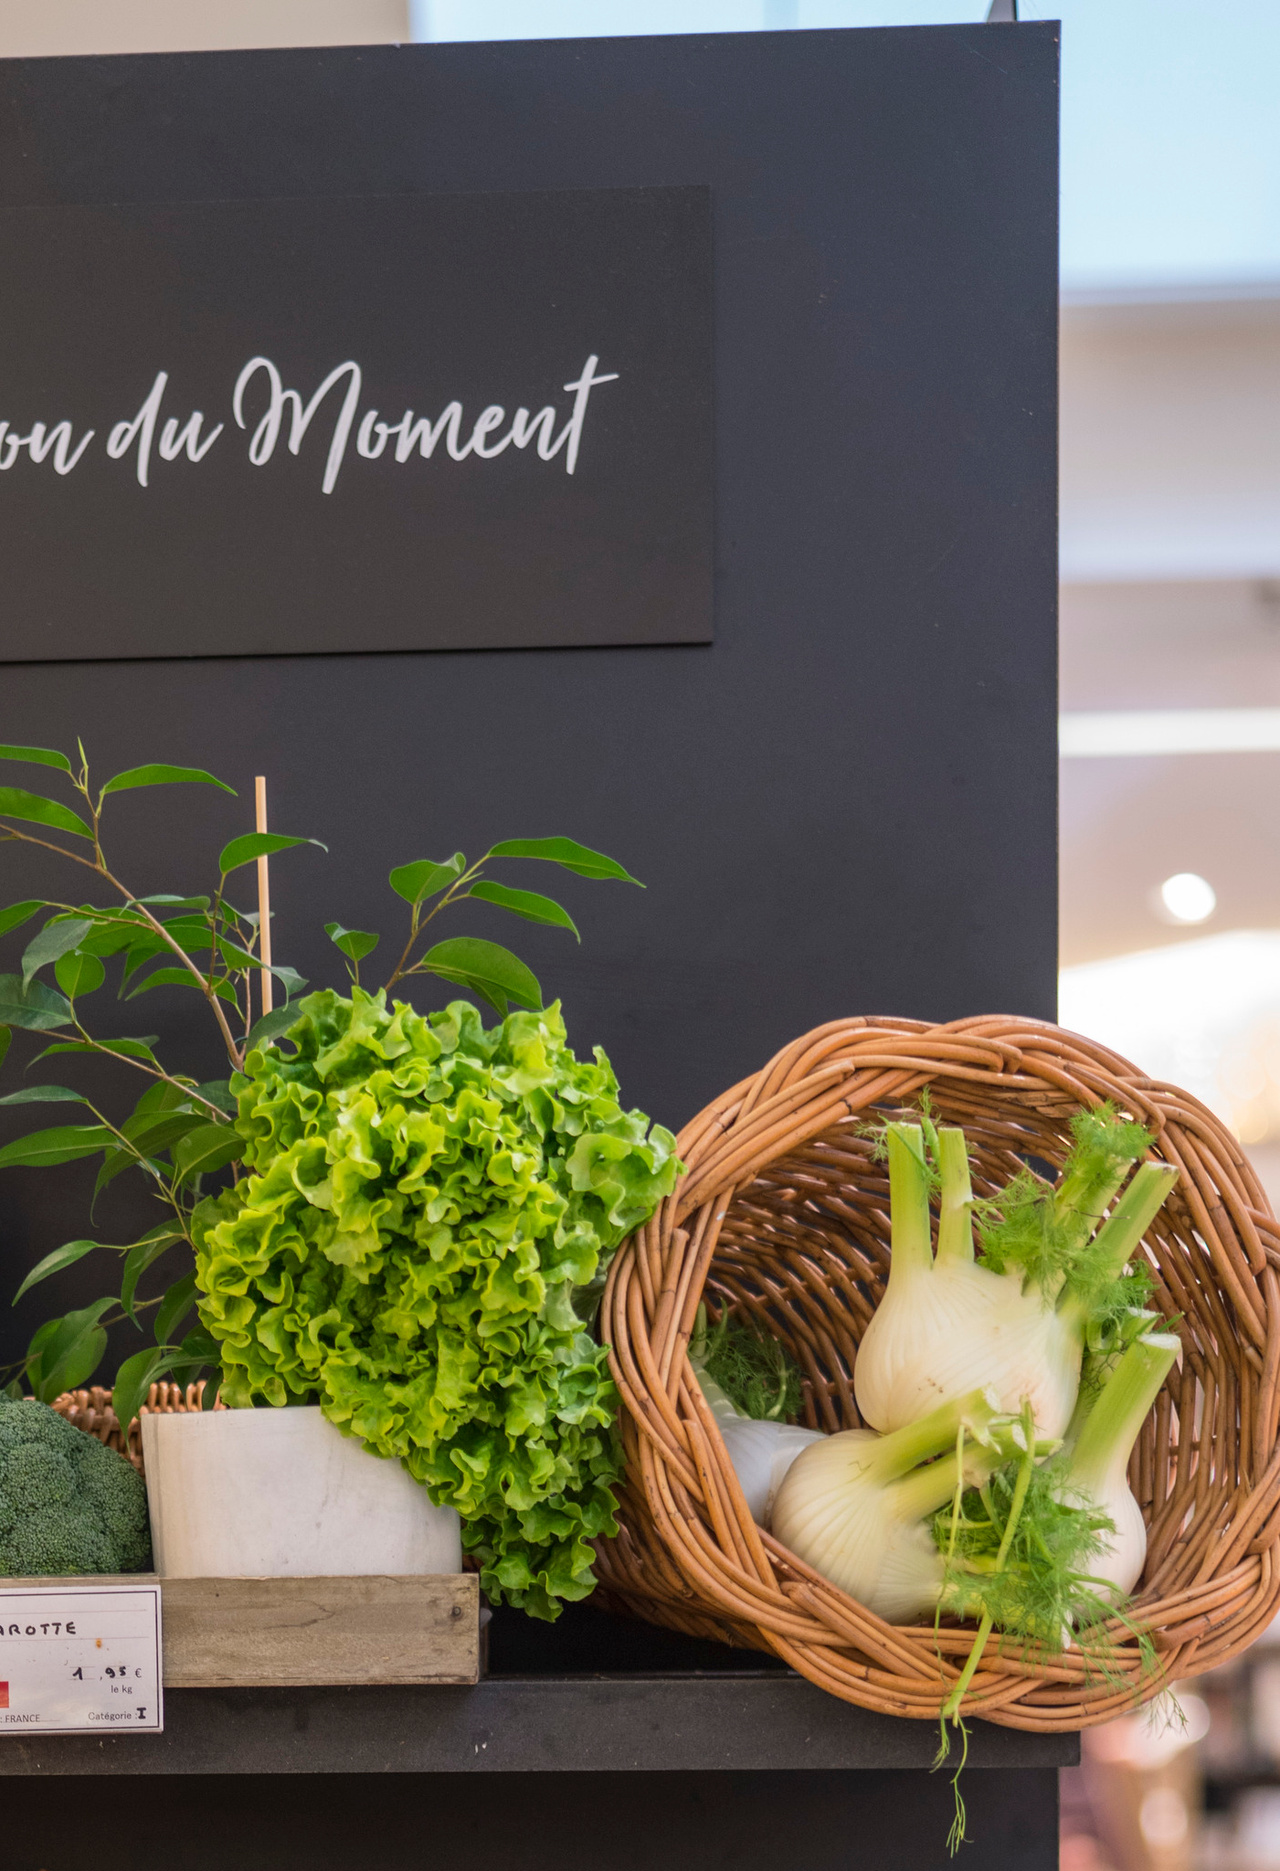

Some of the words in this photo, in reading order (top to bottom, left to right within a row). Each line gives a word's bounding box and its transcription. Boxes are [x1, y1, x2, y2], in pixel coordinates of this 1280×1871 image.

[106, 371, 223, 487] du
[232, 354, 620, 496] Moment
[111, 1685, 119, 1694] le
[122, 1685, 133, 1695] kg
[5, 1714, 40, 1723] FRANCE
[88, 1712, 132, 1721] Catégorie
